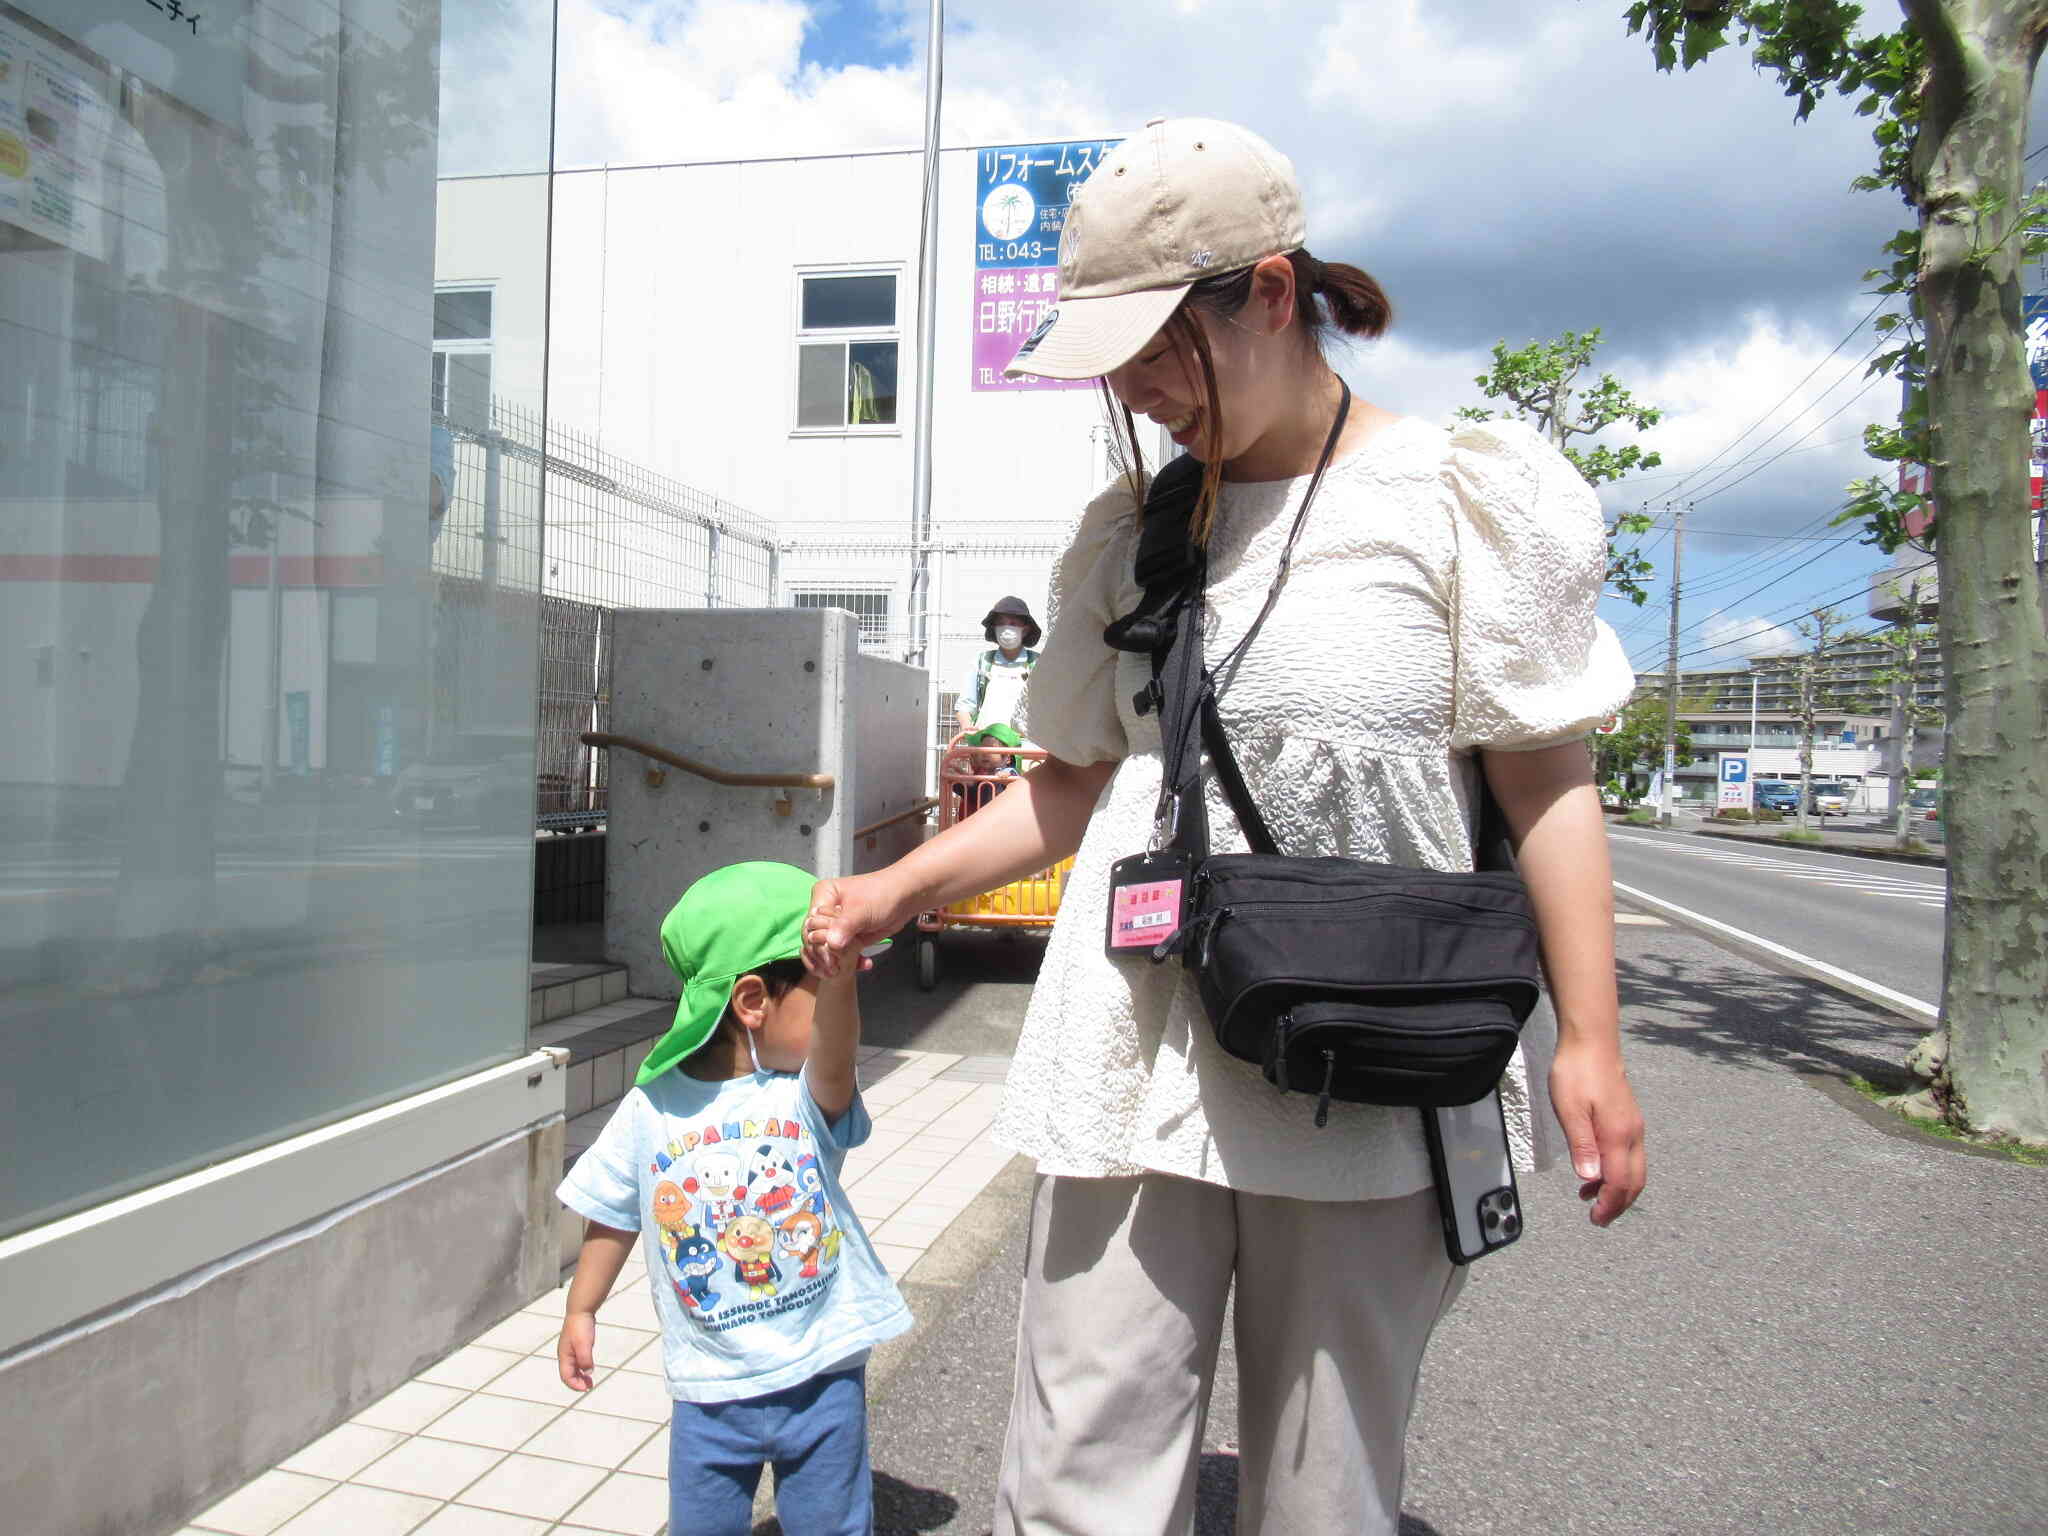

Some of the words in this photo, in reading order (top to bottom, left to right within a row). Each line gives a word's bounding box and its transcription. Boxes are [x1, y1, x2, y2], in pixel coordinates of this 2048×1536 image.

[1724, 760, 1743, 780] P
[656, 1118, 800, 1172] ANPANMAN
[718, 1299, 772, 1322] ISSHODE
